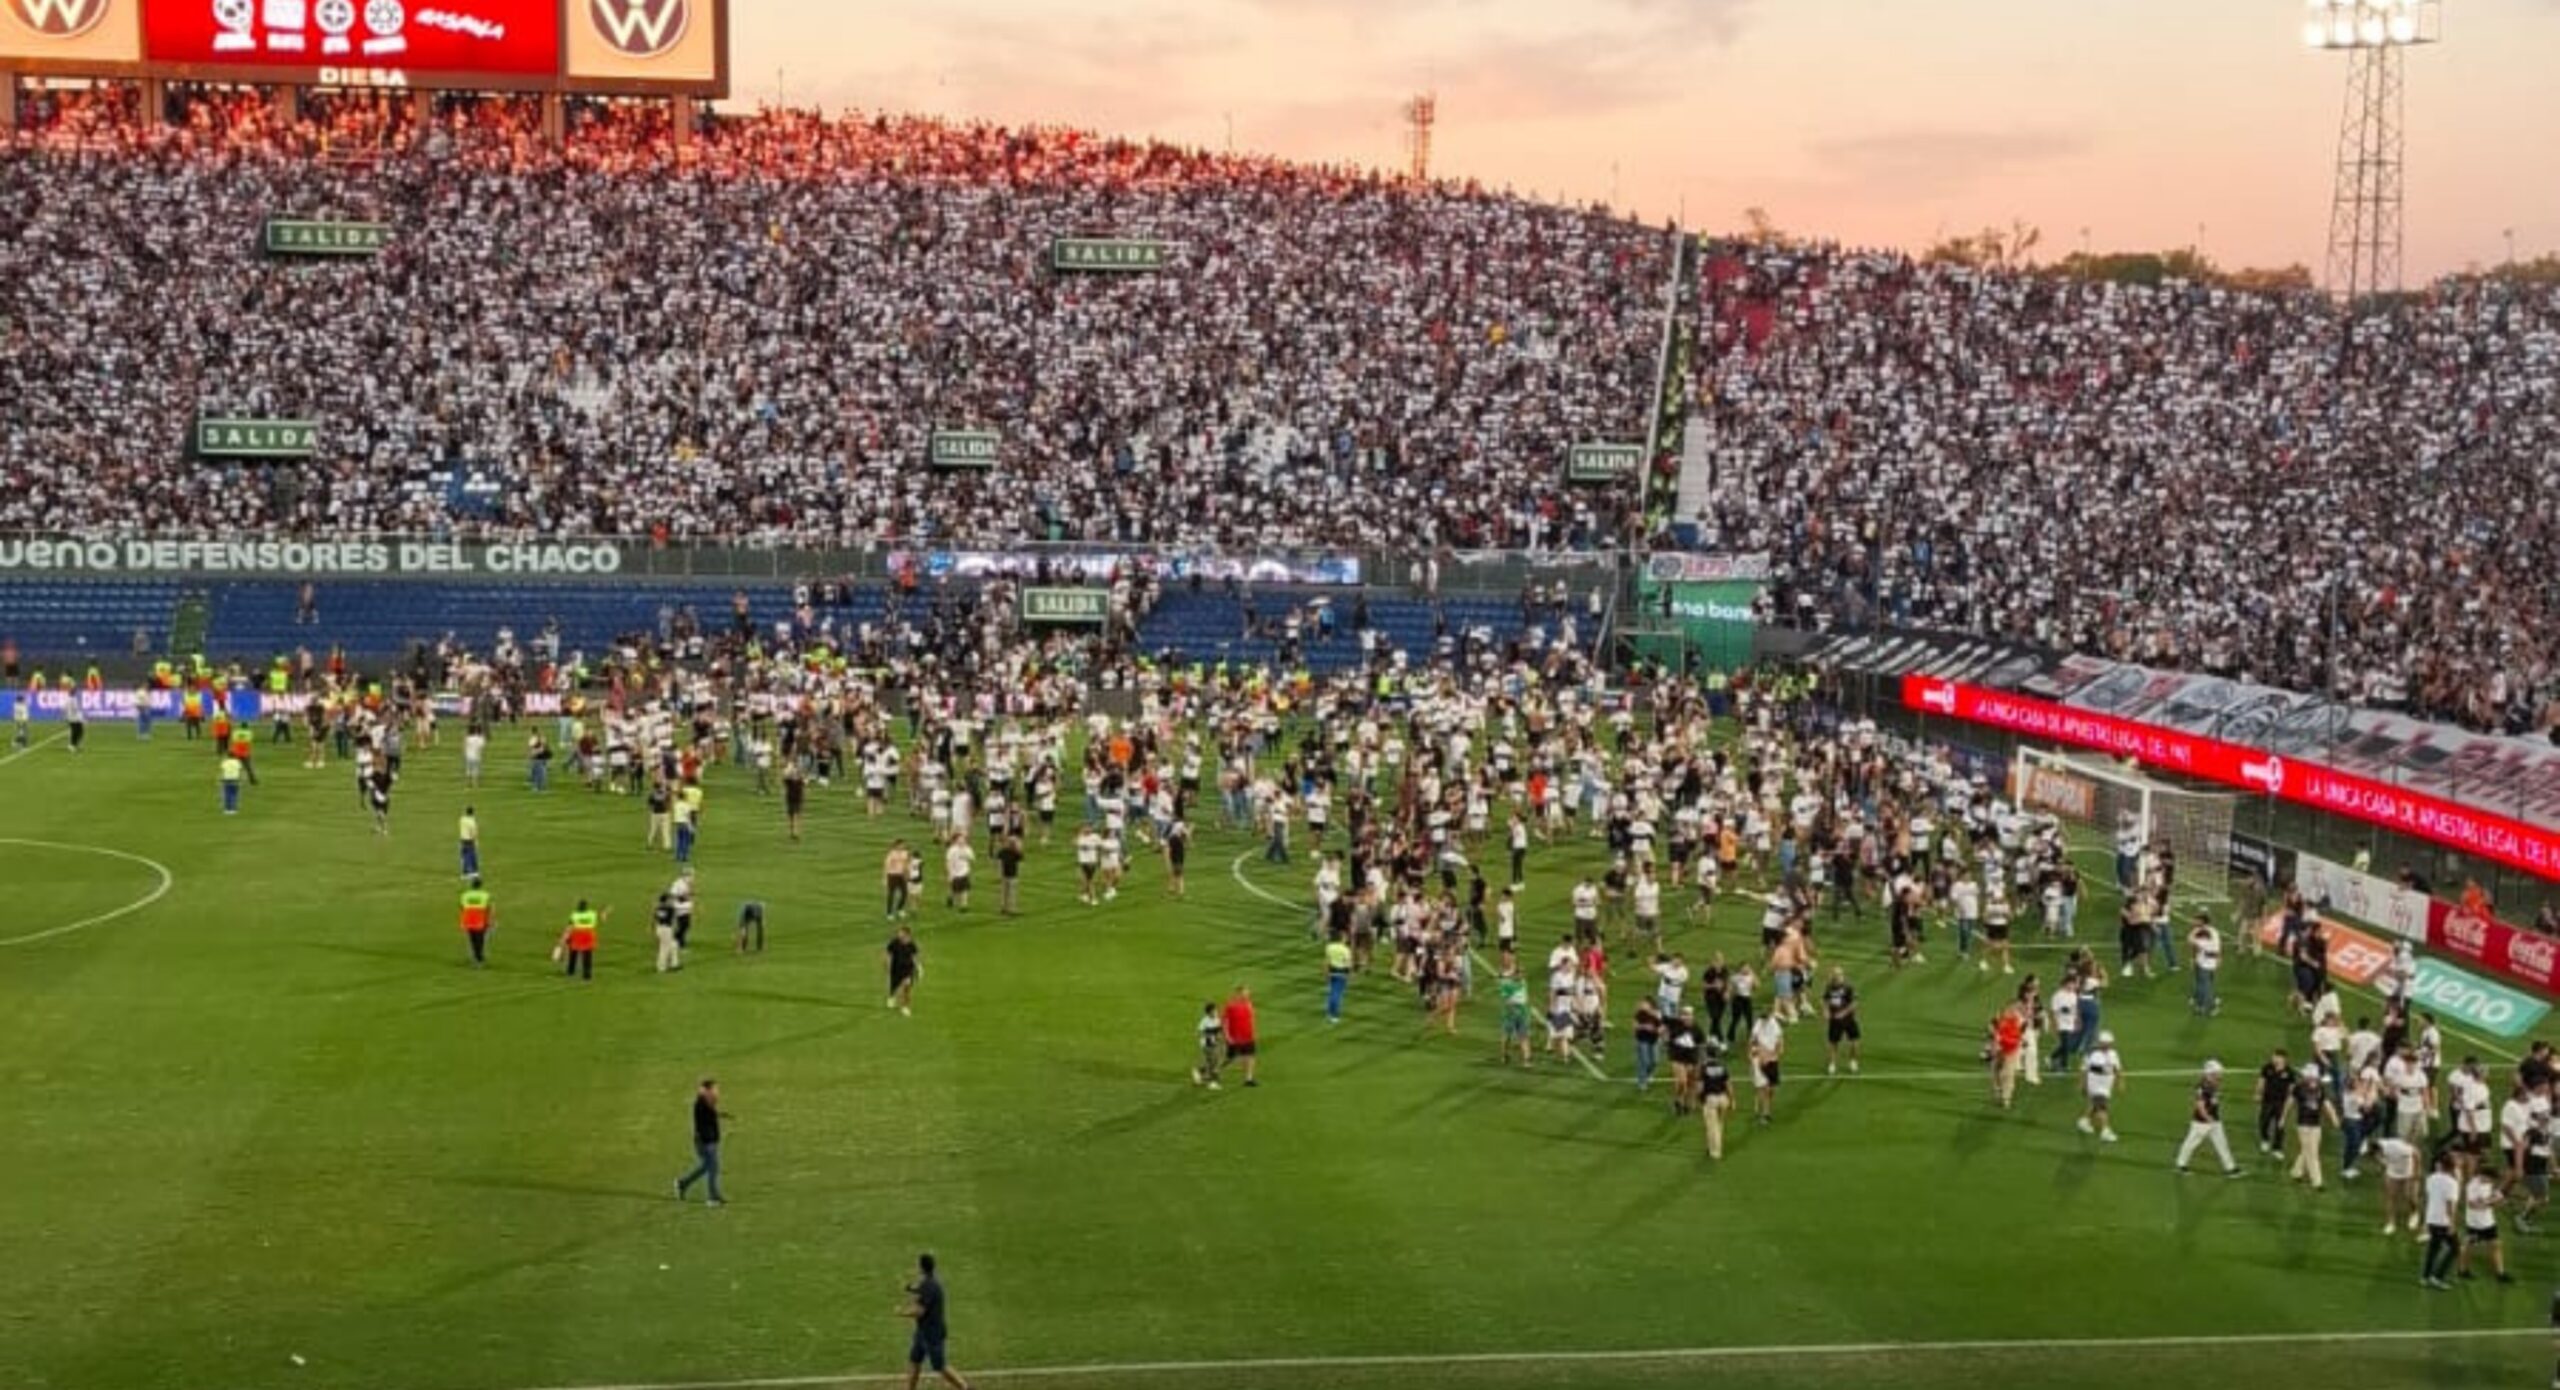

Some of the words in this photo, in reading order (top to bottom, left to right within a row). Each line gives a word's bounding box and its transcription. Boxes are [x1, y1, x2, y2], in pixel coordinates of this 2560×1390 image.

[319, 67, 407, 86] DIESA
[280, 228, 380, 246] SALIDA
[1066, 245, 1158, 261] SALIDA
[206, 428, 317, 447] SALIDA
[127, 541, 388, 572] DEFENSORES
[400, 543, 473, 572] DEL
[486, 545, 621, 572] CHACO
[1034, 594, 1100, 613] SALIDA
[2411, 970, 2514, 1023] ueno
